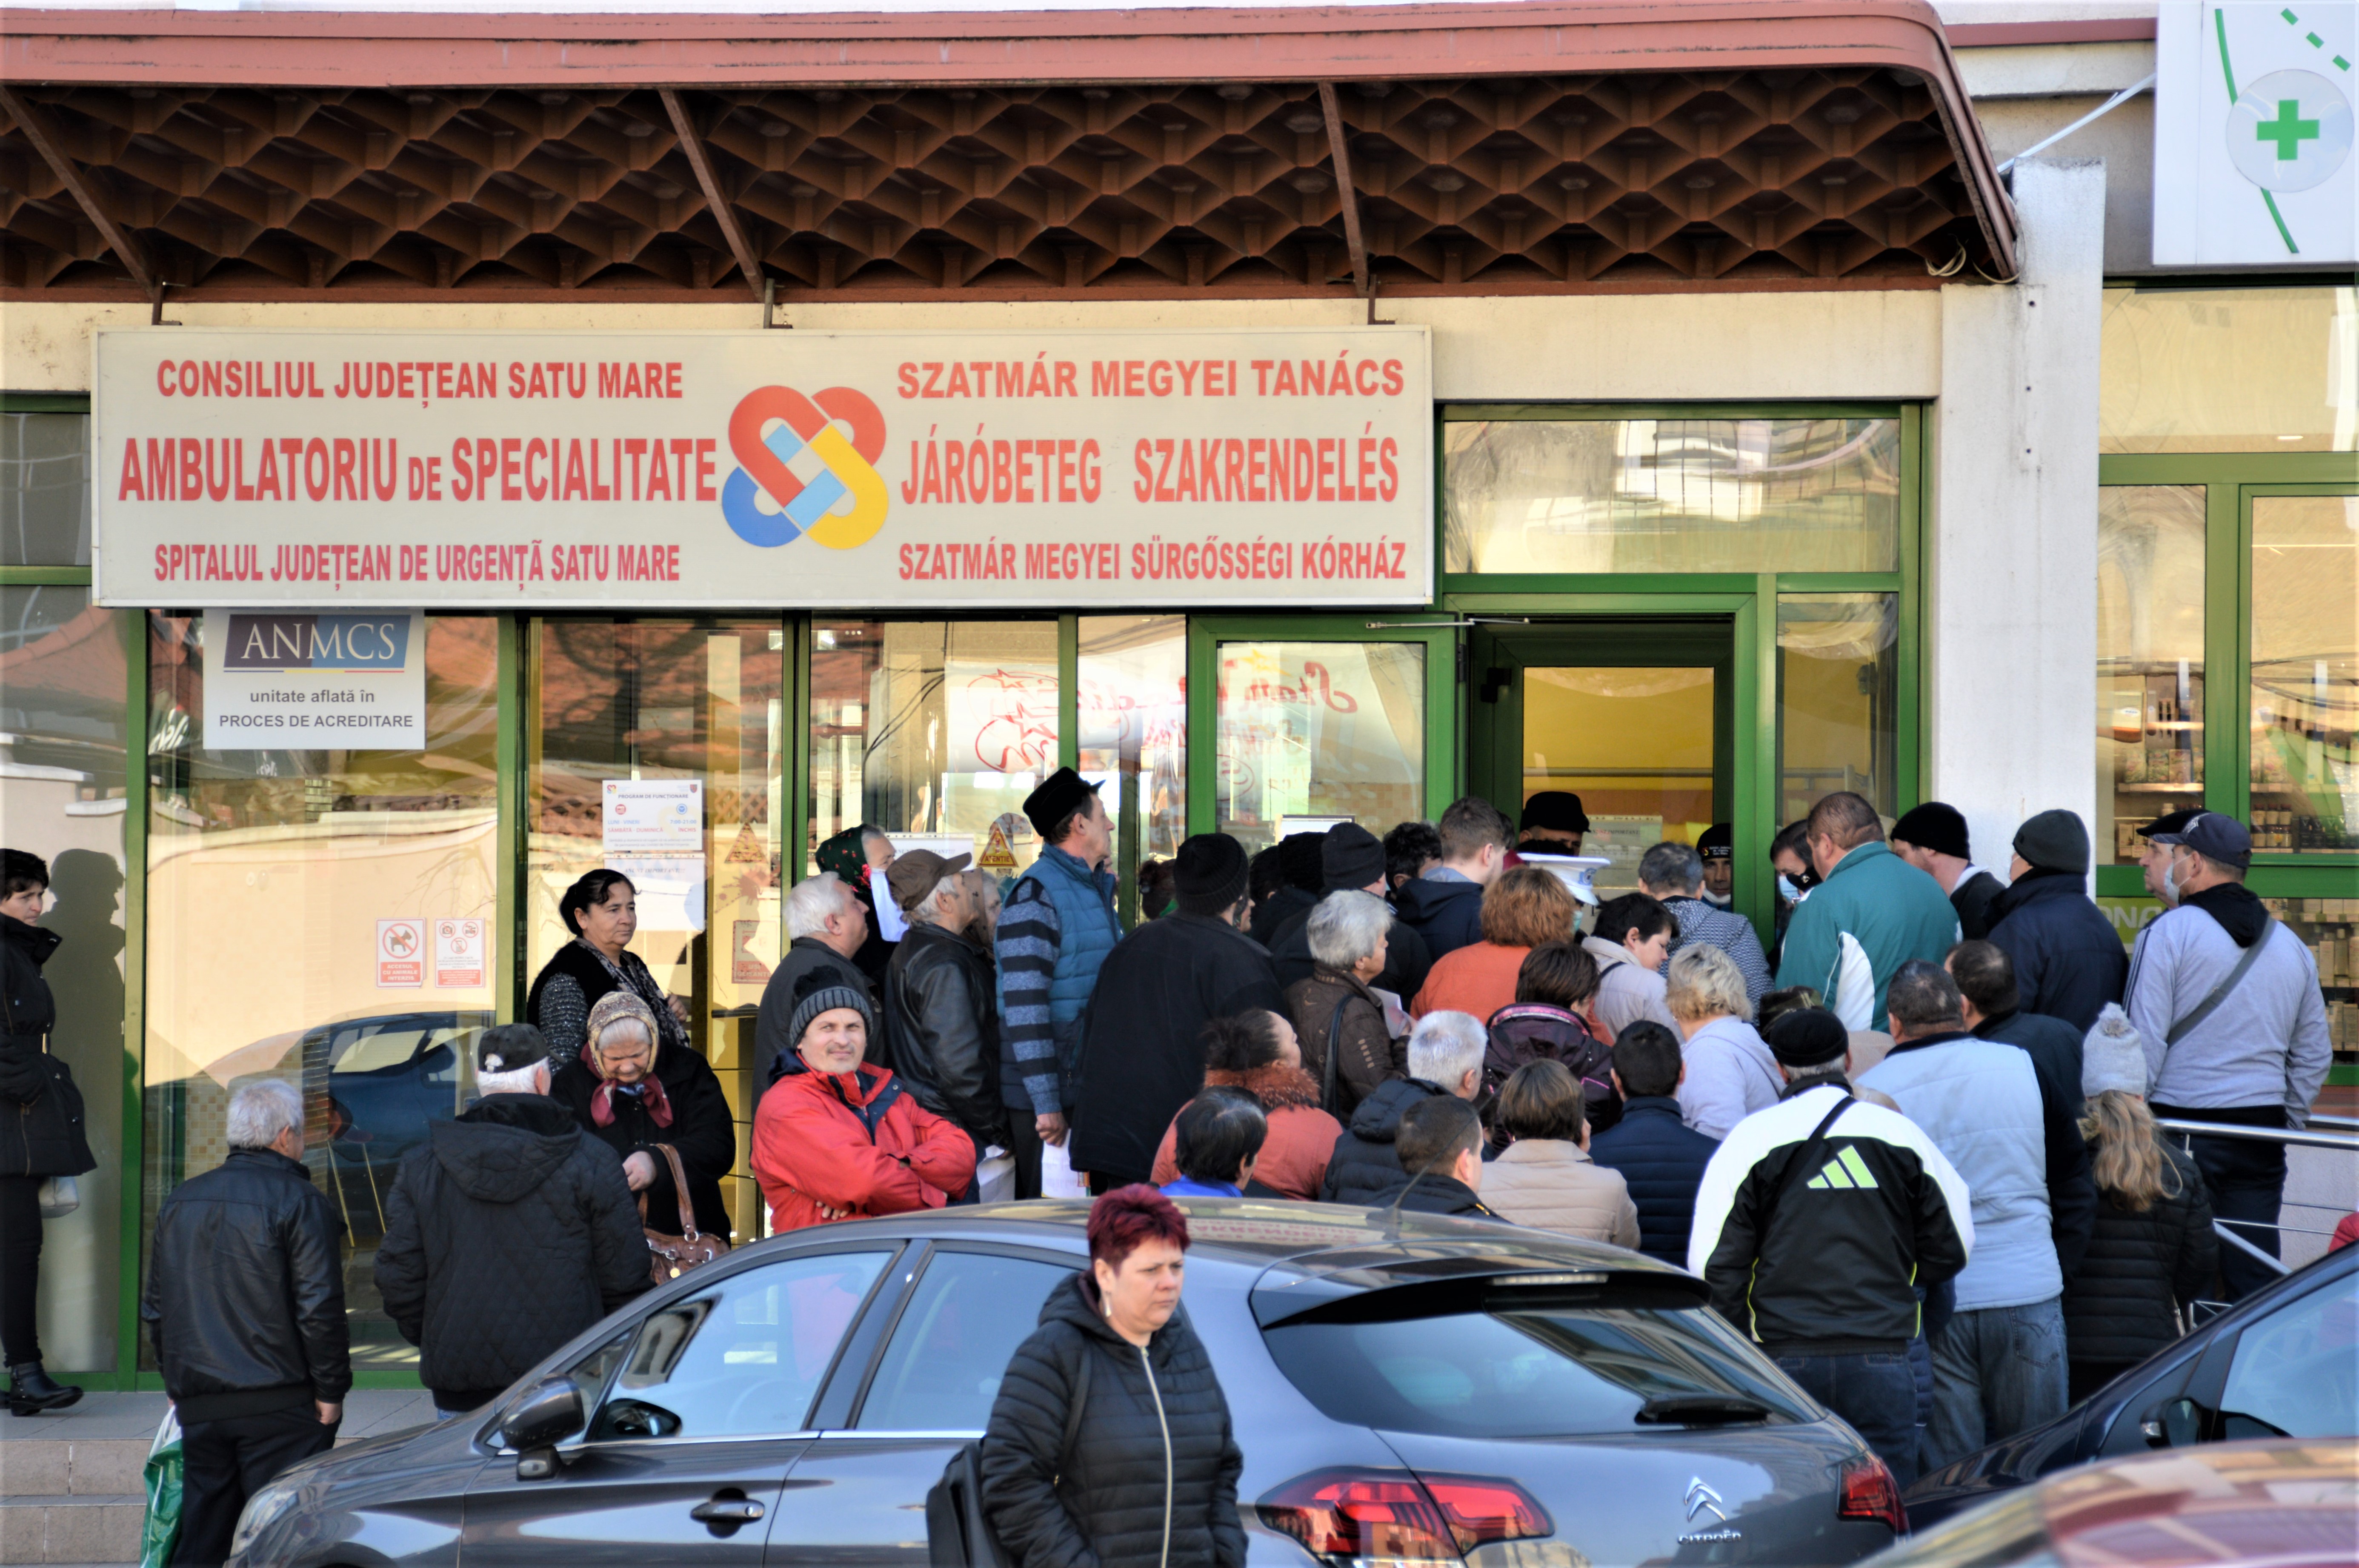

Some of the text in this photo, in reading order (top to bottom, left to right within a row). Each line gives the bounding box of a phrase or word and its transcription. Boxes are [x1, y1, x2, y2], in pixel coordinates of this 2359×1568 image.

[157, 360, 324, 398] CONSILIUL
[508, 361, 587, 399] SATU
[598, 361, 683, 399] MARE
[897, 349, 1404, 399] SZATMÁR MEGYEI TANÁCS
[118, 437, 397, 502] AMBULATORIU
[451, 437, 717, 502] SPECIALITATE
[901, 421, 1399, 505] JÁRÓBETEG SZAKRENDELÉS
[154, 545, 263, 581] SPITALUL
[400, 545, 428, 581] DE
[551, 544, 609, 582] SATU
[617, 545, 680, 581] MARE
[898, 534, 1406, 580] SZATMÁR MEGYEI SÜRGŐSSÉGI KÓRHÁZ
[240, 623, 395, 660] ANMCS
[250, 689, 375, 703] unitate aflată în
[220, 715, 413, 727] PROCES DE ACREDITARE
[1677, 1529, 1741, 1545] CITROËN
